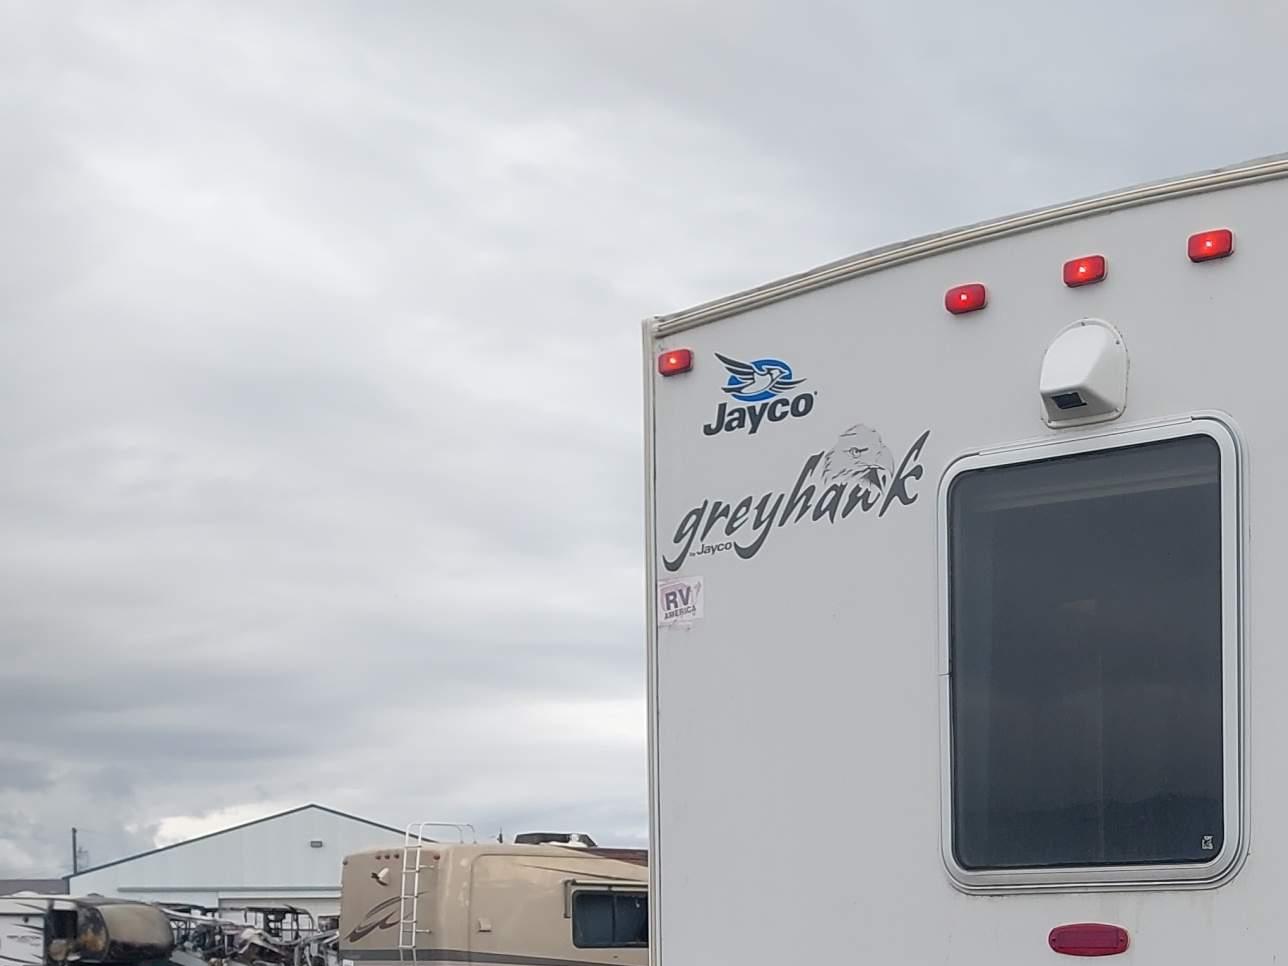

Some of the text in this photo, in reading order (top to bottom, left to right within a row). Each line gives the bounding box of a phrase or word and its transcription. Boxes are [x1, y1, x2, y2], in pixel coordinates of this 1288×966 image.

[703, 391, 814, 436] Jayco
[662, 429, 931, 572] greyhawk
[696, 541, 732, 556] Jayco
[664, 585, 692, 611] RV
[664, 604, 697, 620] AMERICA
